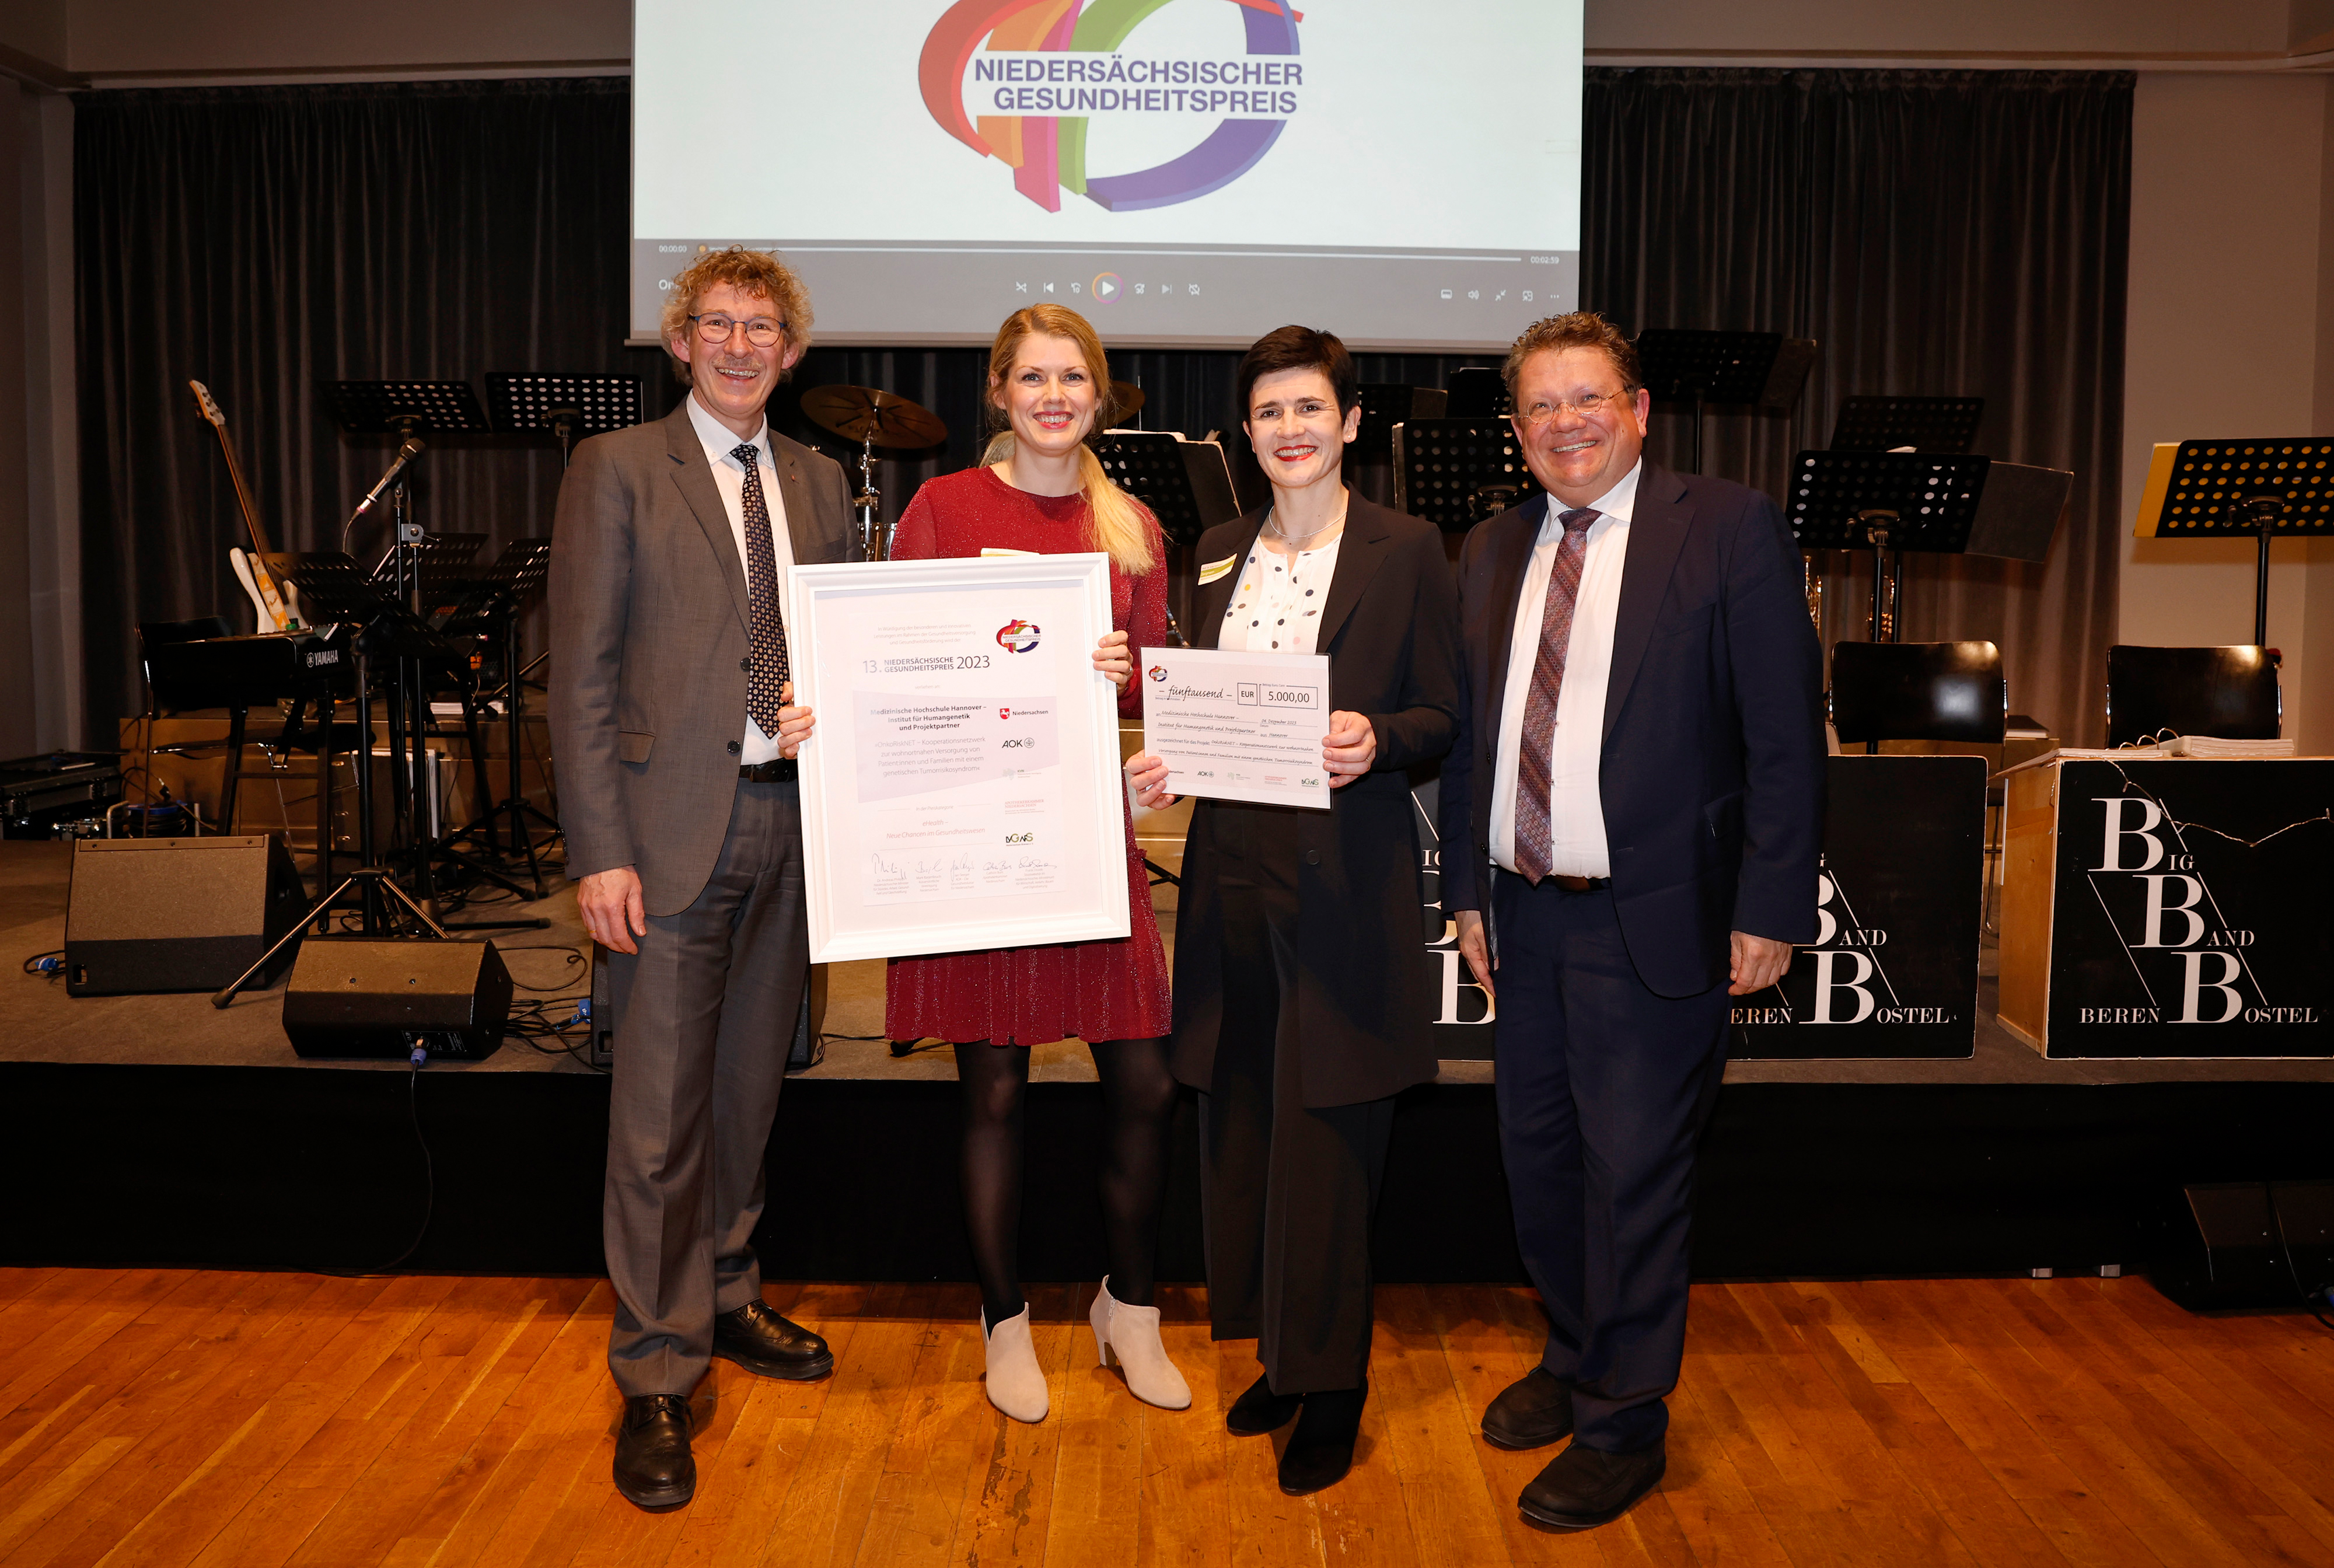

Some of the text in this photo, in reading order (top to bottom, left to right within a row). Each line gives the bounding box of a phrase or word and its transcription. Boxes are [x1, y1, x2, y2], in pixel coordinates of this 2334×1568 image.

[975, 54, 1302, 85] NIEDERSÄCHSISCHER
[994, 88, 1297, 113] GESUNDHEITSPREIS
[315, 649, 338, 666] YAMAHA
[884, 656, 953, 665] NIEDERSÄCHSISCHE
[956, 655, 990, 669] 2023
[862, 661, 882, 673] 13.
[884, 663, 954, 673] GESUNDHEITSPREIS
[1167, 685, 1224, 701] fünftausend
[1269, 691, 1309, 703] 5.000,00
[1183, 724, 1214, 732] Humangenetik
[922, 736, 986, 745] Kooperationsnetzwerk
[1002, 740, 1022, 748] AOK
[892, 749, 934, 757] wohnortnahen
[883, 769, 918, 777] genetischen
[902, 830, 926, 839] Chancen
[935, 827, 986, 836] Gesundheitswesen
[2088, 798, 2195, 871] BIG
[2129, 875, 2255, 947] BAND
